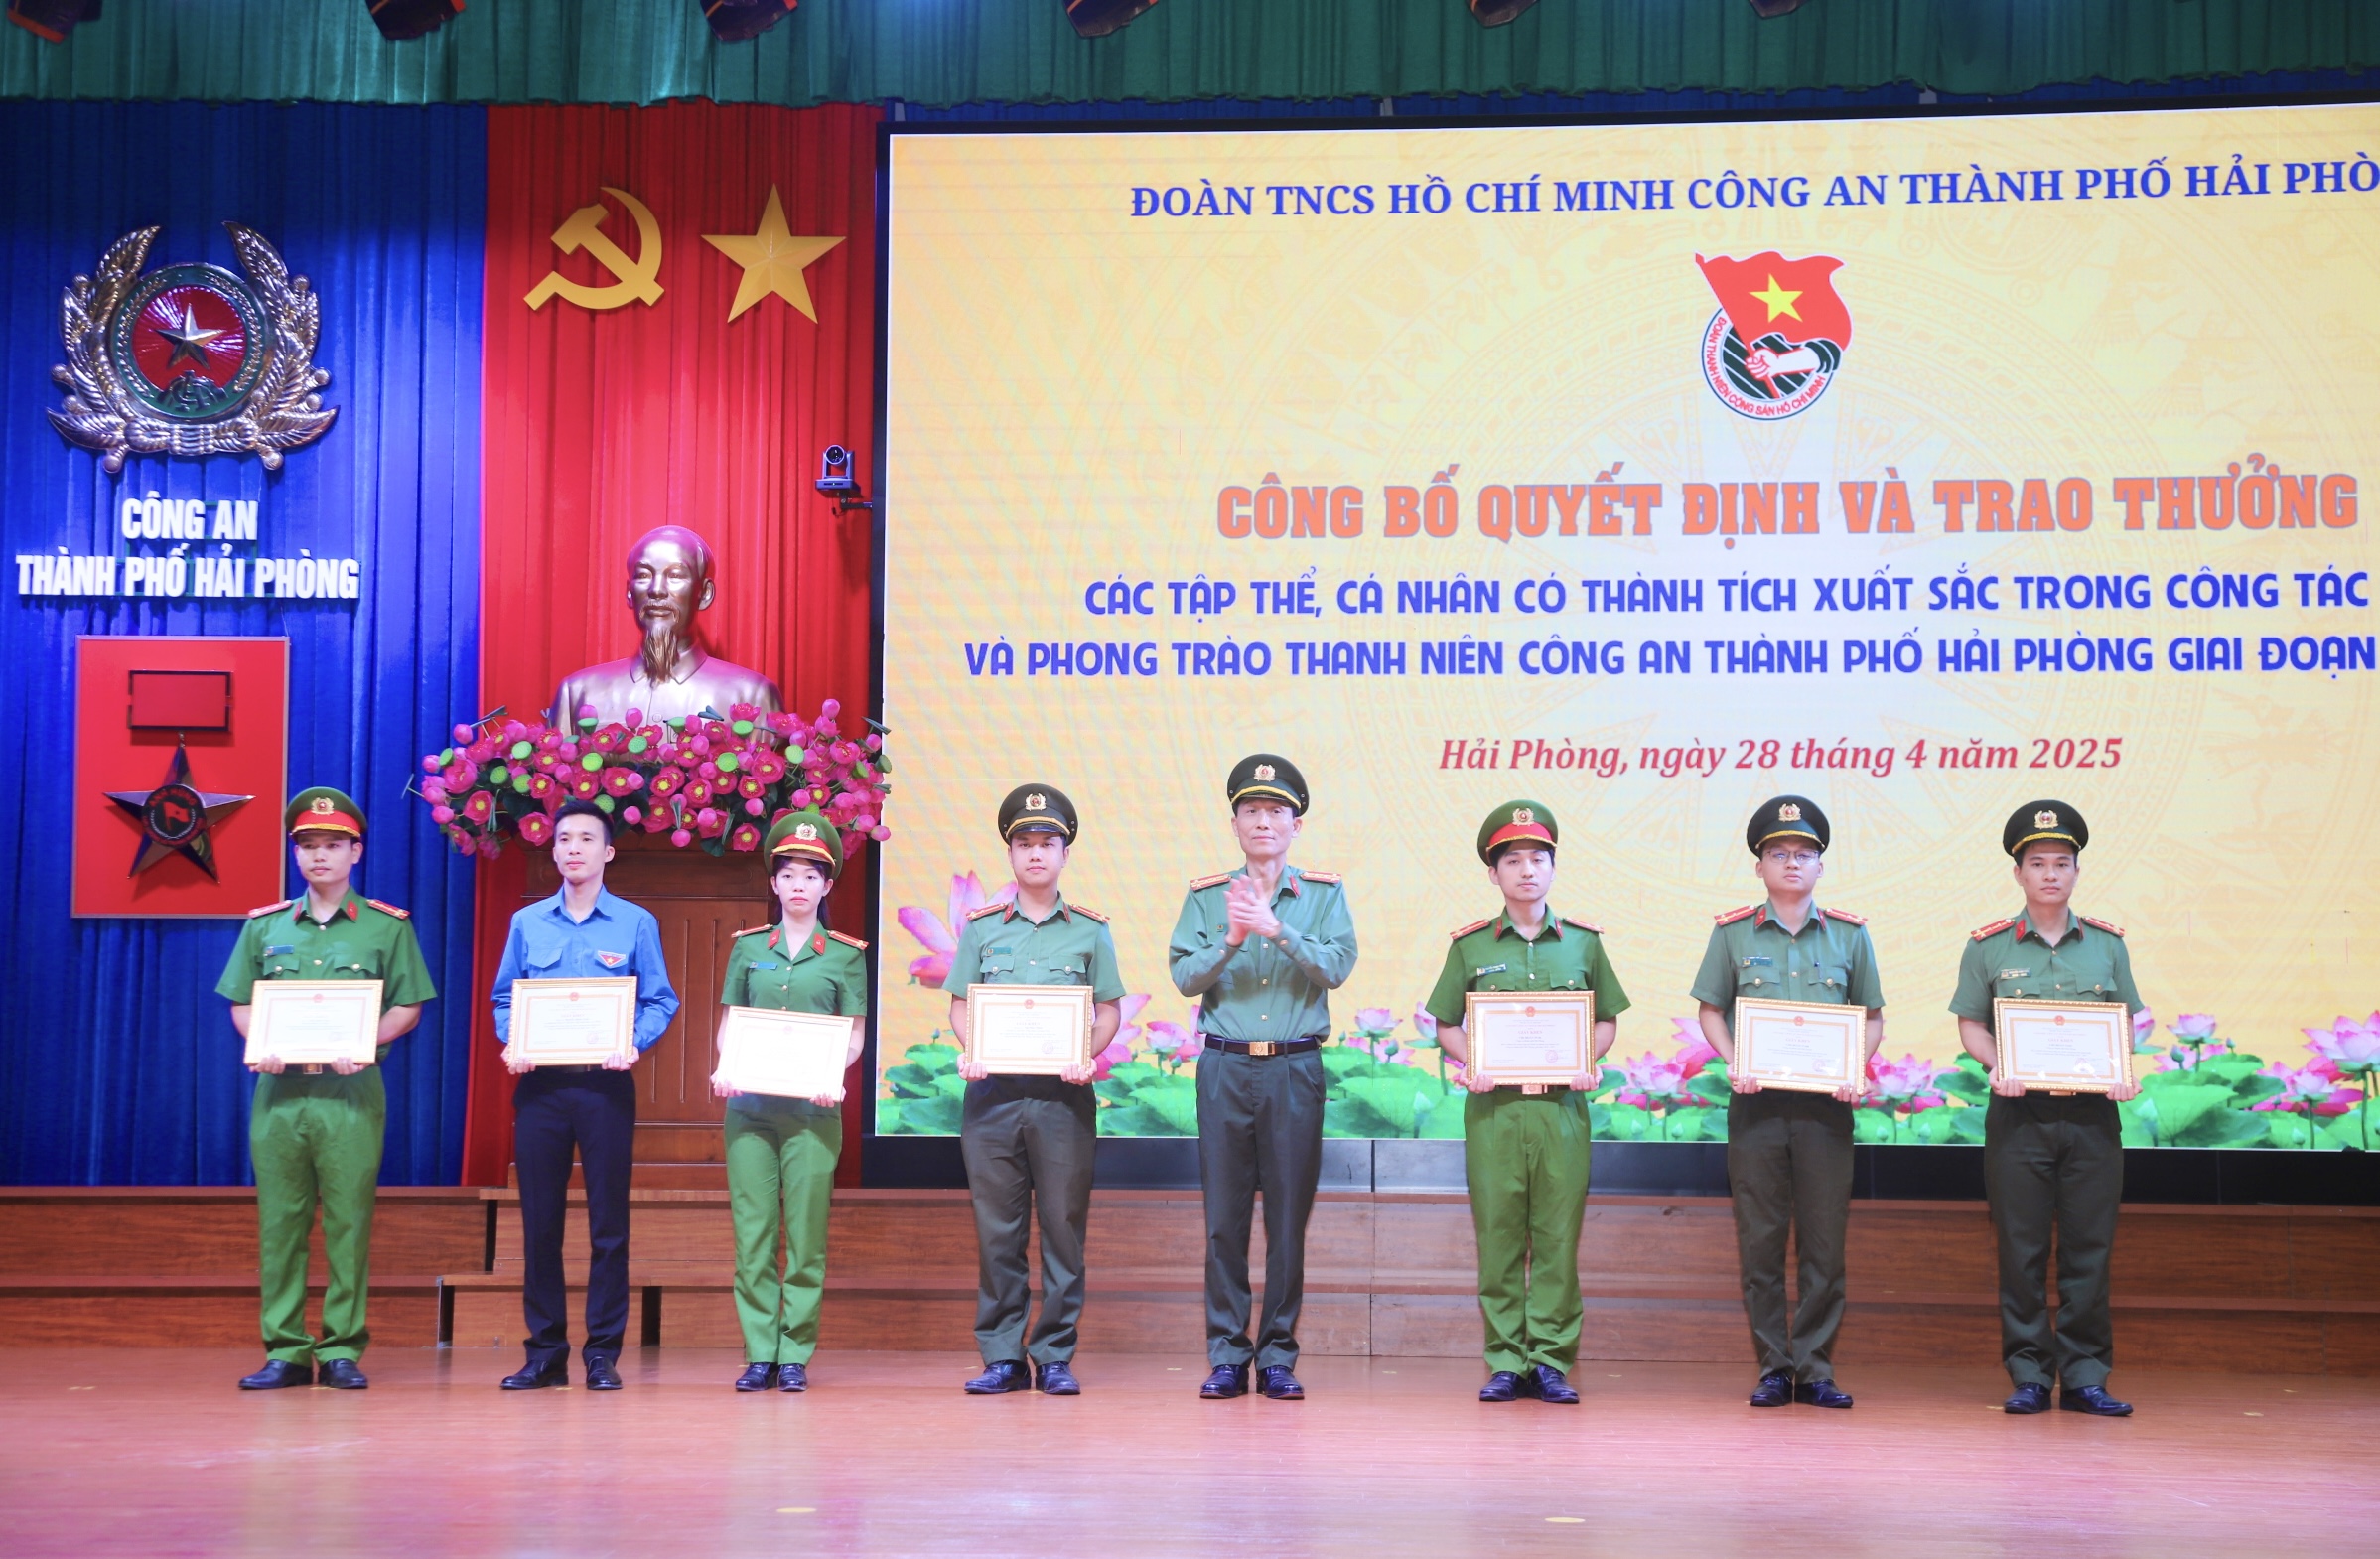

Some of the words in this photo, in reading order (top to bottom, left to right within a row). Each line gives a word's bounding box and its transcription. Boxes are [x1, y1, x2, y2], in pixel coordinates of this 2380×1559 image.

[1133, 179, 1254, 216] ĐOÀN
[1266, 185, 1374, 215] TNCS
[1389, 174, 1451, 213] HỒ
[1466, 174, 1540, 213] CHÍ
[1554, 180, 1674, 212] MINH
[1688, 170, 1810, 209] CÔNG
[1824, 175, 1889, 206] AN
[1899, 164, 2063, 204] THÀNH
[2076, 157, 2170, 199] PHỐ
[2186, 154, 2270, 197] HẢI
[122, 491, 204, 539] CÔNG
[213, 500, 257, 539] AN
[1218, 472, 1363, 538] CÔNG
[1384, 464, 1459, 537] BỐ
[1478, 462, 1662, 541] QUYẾT
[1683, 482, 1819, 548] ĐỊNH
[1840, 467, 1914, 533] VÀ
[1934, 477, 2092, 532] TRAO
[2114, 453, 2357, 529] THƯỞNG
[16, 547, 115, 595] THÀNH
[125, 543, 188, 597] PHỐ
[195, 543, 244, 597] HẢI
[255, 549, 359, 598] PHÒNG
[1085, 574, 1154, 615] CÁC
[1168, 574, 1236, 623] TẬP
[1250, 566, 1322, 618] THỂ,
[1336, 573, 1383, 614] CÁ
[1397, 572, 1500, 614] NHÂN
[1514, 572, 1567, 614] CÓ
[1582, 571, 1703, 613] THÀNH
[1718, 571, 1796, 612] TÍCH
[1813, 564, 1914, 612] XUẤT
[1928, 562, 1999, 611] SẮC
[2013, 574, 2151, 610] TRONG
[2166, 566, 2279, 609] CÔNG
[2294, 564, 2369, 607] TÁC
[965, 636, 1014, 675] VÀ
[1028, 642, 1157, 676] PHONG
[1172, 636, 1271, 676] TRÀO
[1285, 641, 1406, 675] THANH
[1421, 634, 1503, 675] NIÊN
[1519, 634, 1624, 675] CÔNG
[1639, 640, 1691, 674] AN
[1704, 633, 1828, 674] THÀNH
[1843, 626, 1923, 673] PHỐ
[1938, 628, 2000, 673] HẢI
[2014, 630, 2153, 672] PHÒNG
[2168, 637, 2243, 672] GIAI
[2258, 636, 2376, 679] ĐOẠN
[1440, 739, 1500, 769] Hải
[1510, 739, 1627, 778] Phòng,
[1640, 738, 1726, 777] ngày
[1736, 740, 1780, 769] 28
[1791, 738, 1894, 777] tháng
[1906, 739, 1926, 768] 4
[1939, 740, 2018, 768] năm
[2030, 738, 2123, 768] 2025
